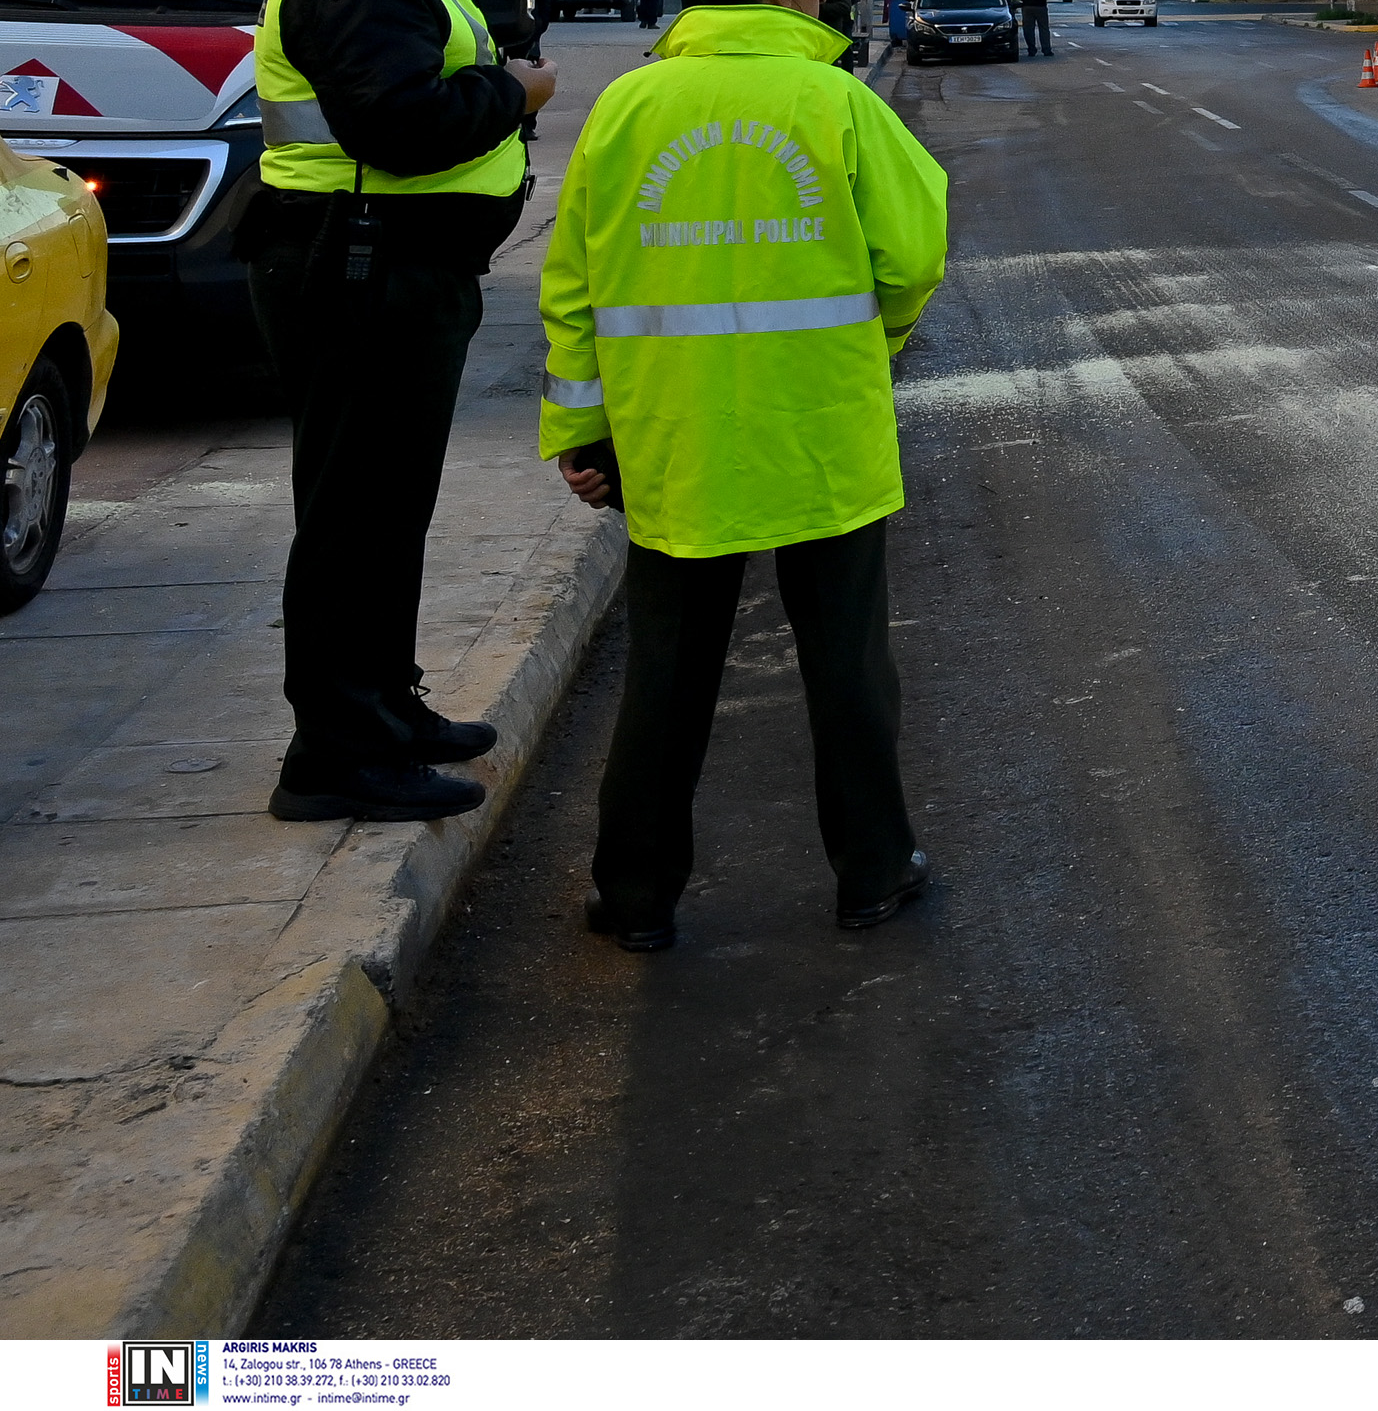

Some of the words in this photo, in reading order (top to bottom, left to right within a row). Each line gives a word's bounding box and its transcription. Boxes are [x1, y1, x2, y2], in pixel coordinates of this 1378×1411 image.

[637, 121, 724, 214] ΔΗΜΟΤΙΚΗ
[730, 119, 824, 209] ΑΣΤΥΝΟΜΙΑ
[639, 220, 747, 248] MUNICIPAL
[753, 217, 826, 244] POLICE
